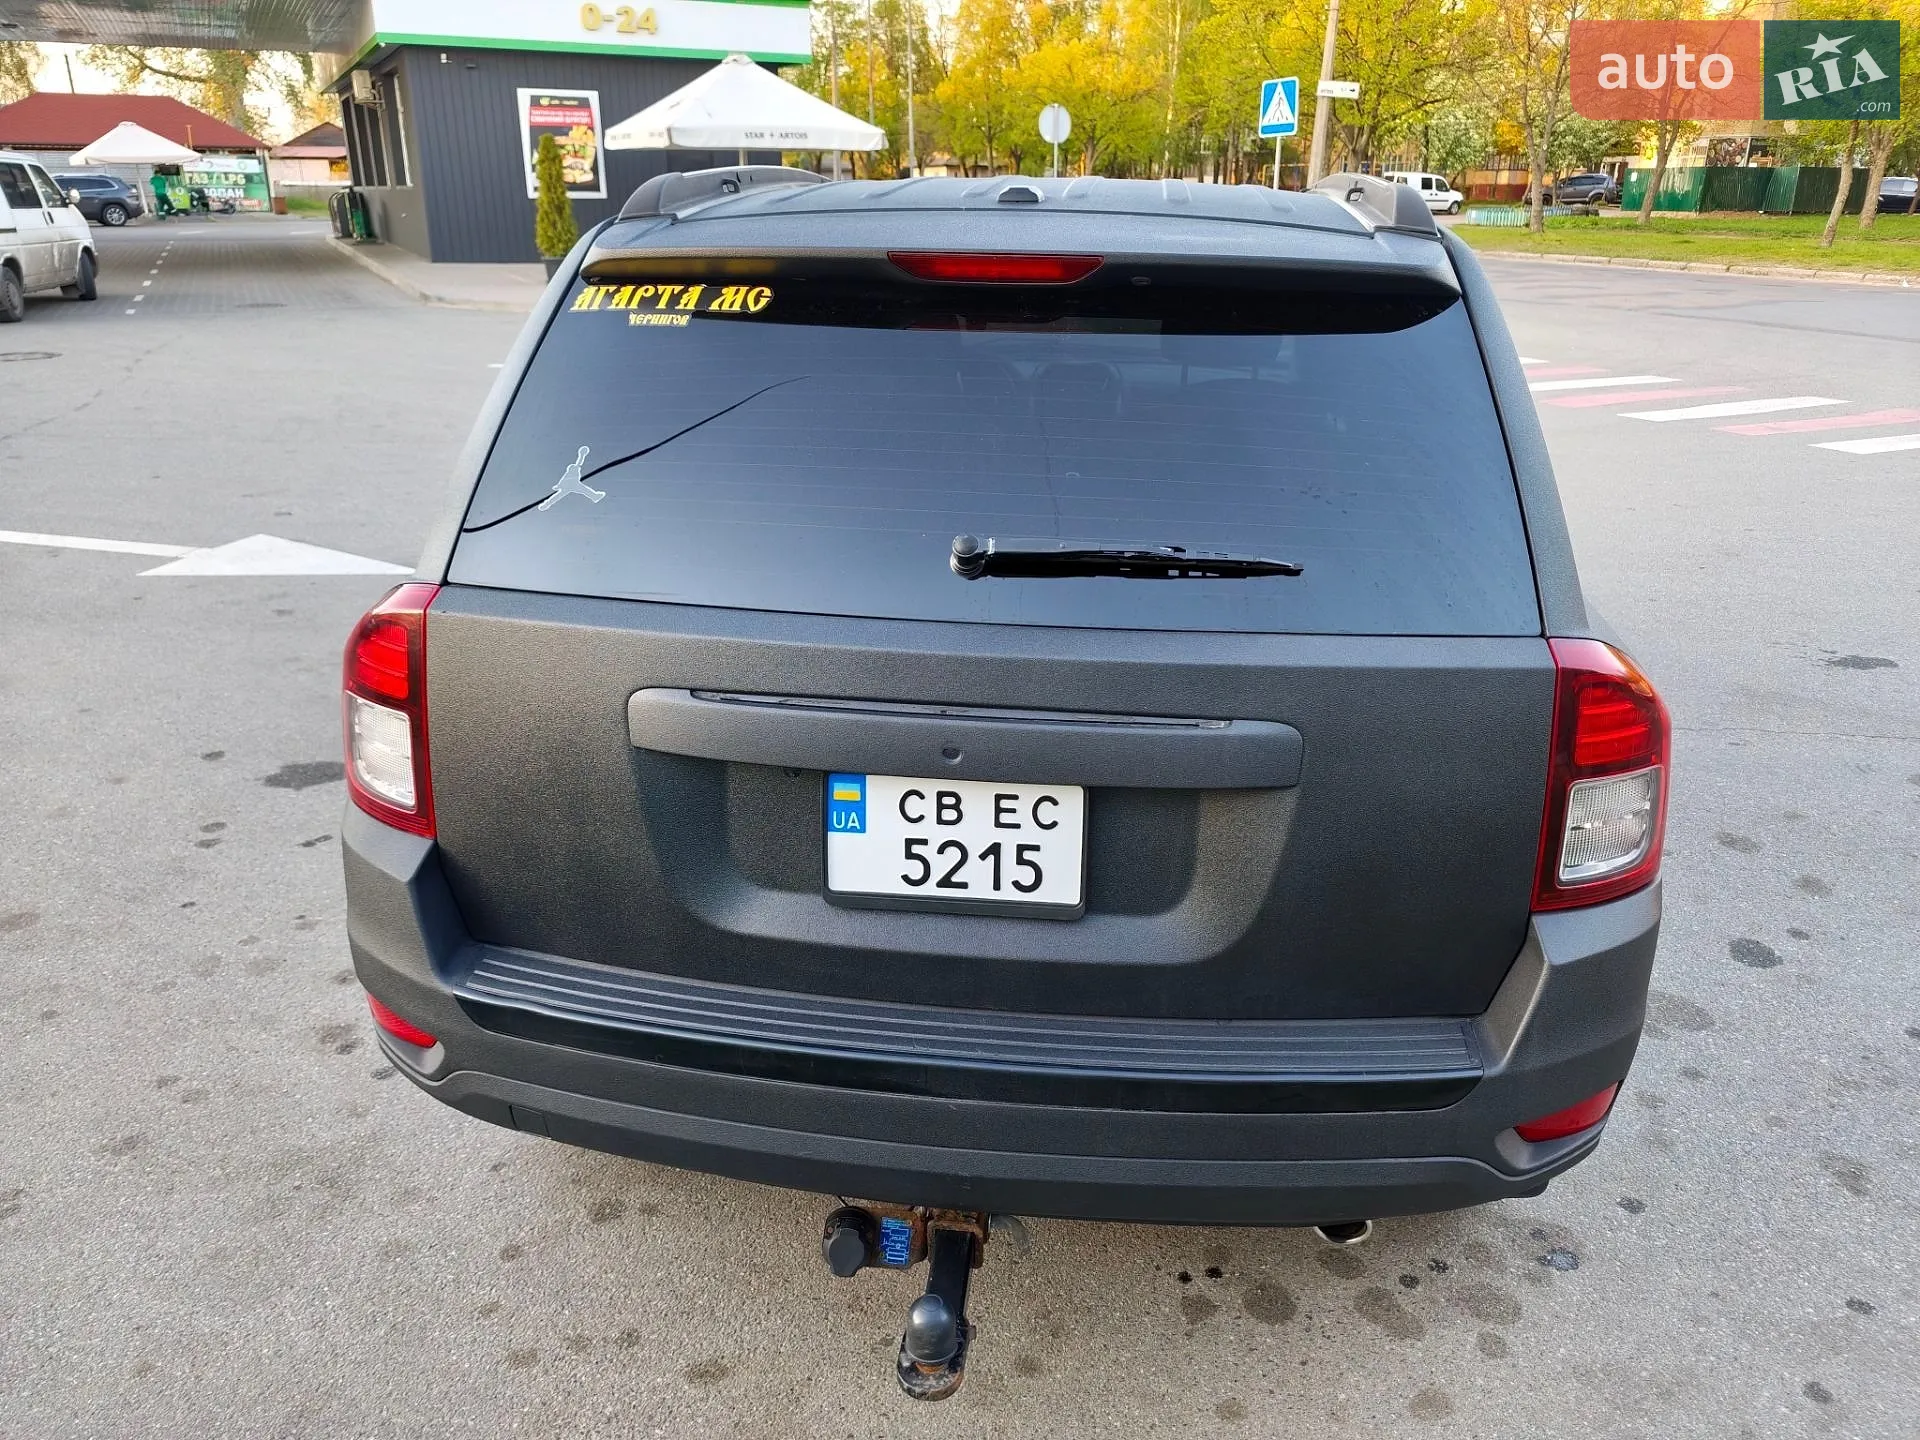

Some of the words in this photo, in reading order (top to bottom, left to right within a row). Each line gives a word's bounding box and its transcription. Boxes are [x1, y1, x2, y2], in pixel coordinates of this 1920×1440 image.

[581, 3, 657, 34] 0-24
[569, 285, 705, 311] АГАРТА
[832, 811, 861, 830] UA
[898, 788, 964, 826] CB
[994, 793, 1060, 831] EC
[900, 838, 1043, 893] 5215
